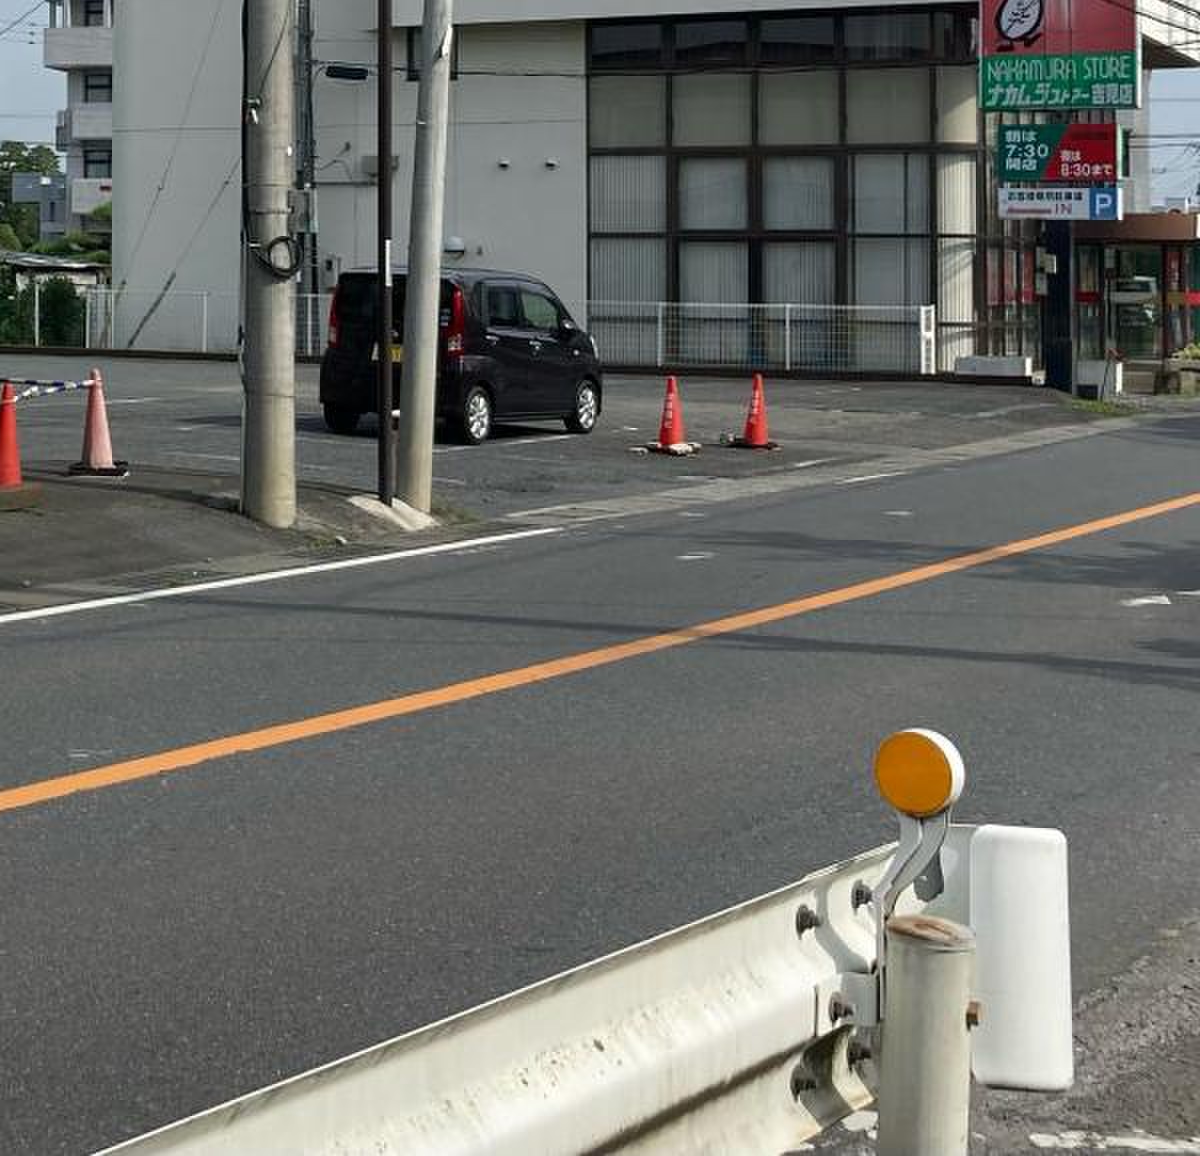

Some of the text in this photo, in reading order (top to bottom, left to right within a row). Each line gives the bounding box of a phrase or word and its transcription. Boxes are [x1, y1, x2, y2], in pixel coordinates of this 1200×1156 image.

[988, 55, 1131, 81] NAKAMURA STORE
[1006, 144, 1049, 157] 7:30
[1096, 193, 1112, 216] P
